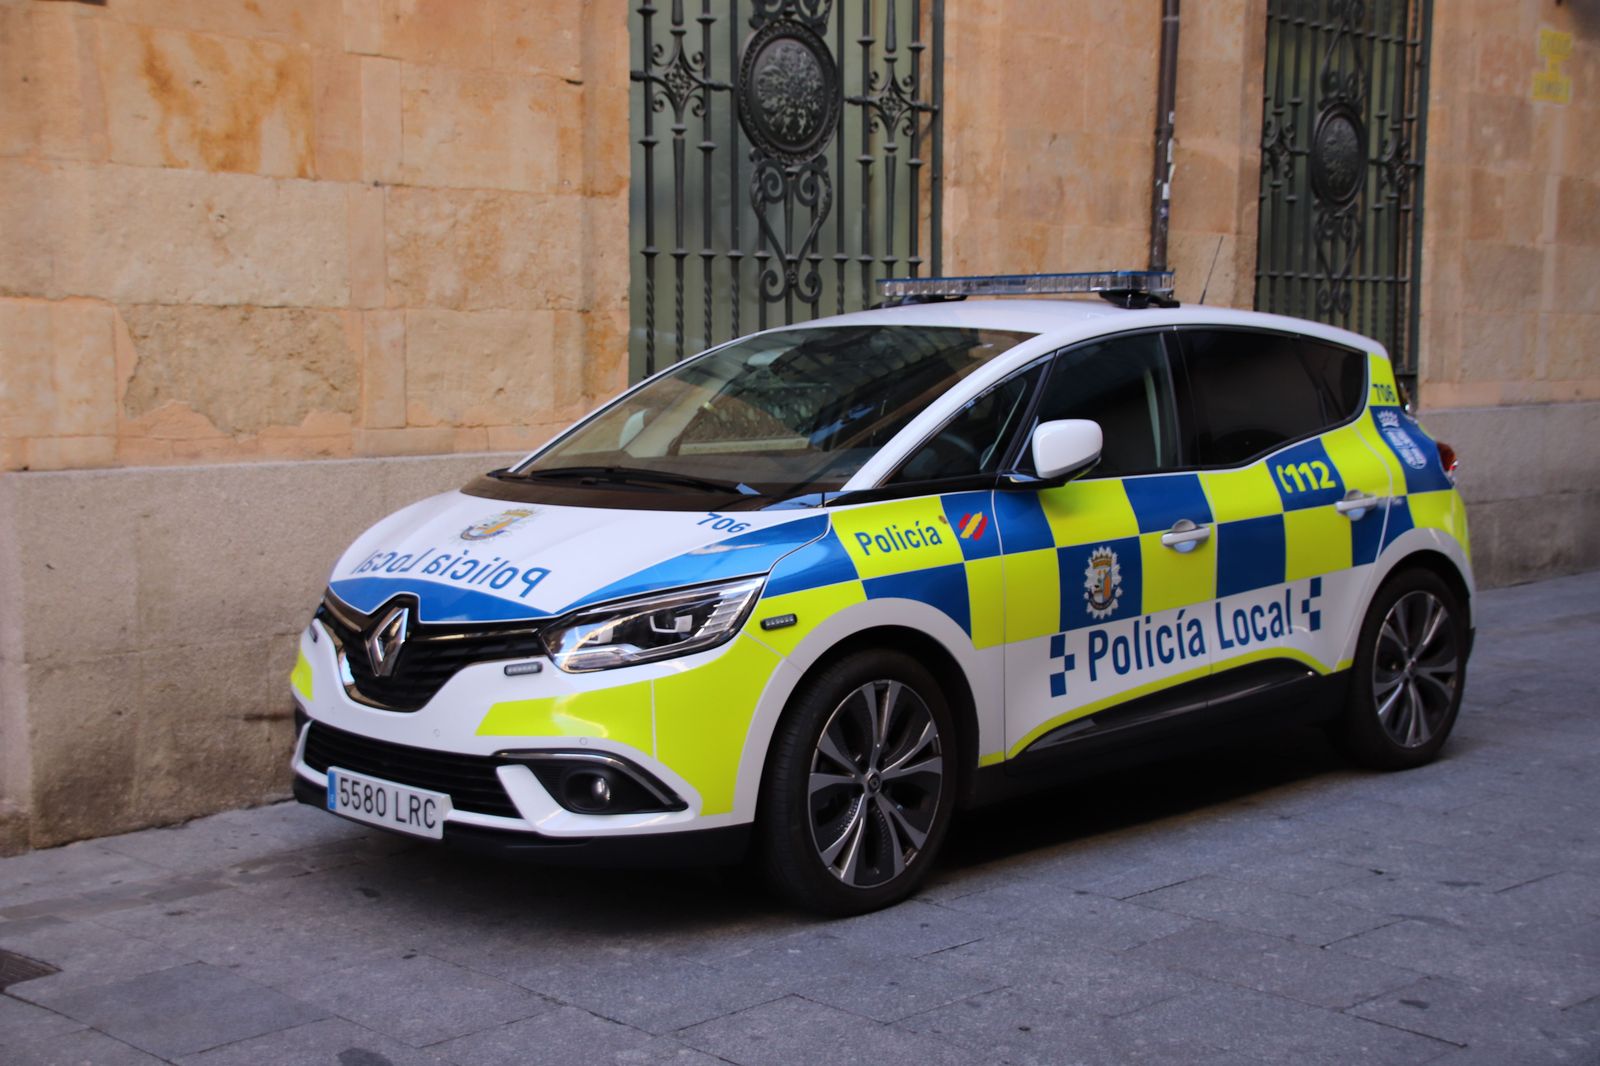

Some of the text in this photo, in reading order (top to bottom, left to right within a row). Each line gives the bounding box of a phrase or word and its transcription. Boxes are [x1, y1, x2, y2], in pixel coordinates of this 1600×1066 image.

[1372, 384, 1396, 402] 706
[1284, 461, 1337, 492] 112
[697, 512, 752, 533] 706
[854, 521, 943, 556] Policía
[1088, 588, 1293, 682] Policía Local
[340, 777, 436, 829] 5580 LRC
